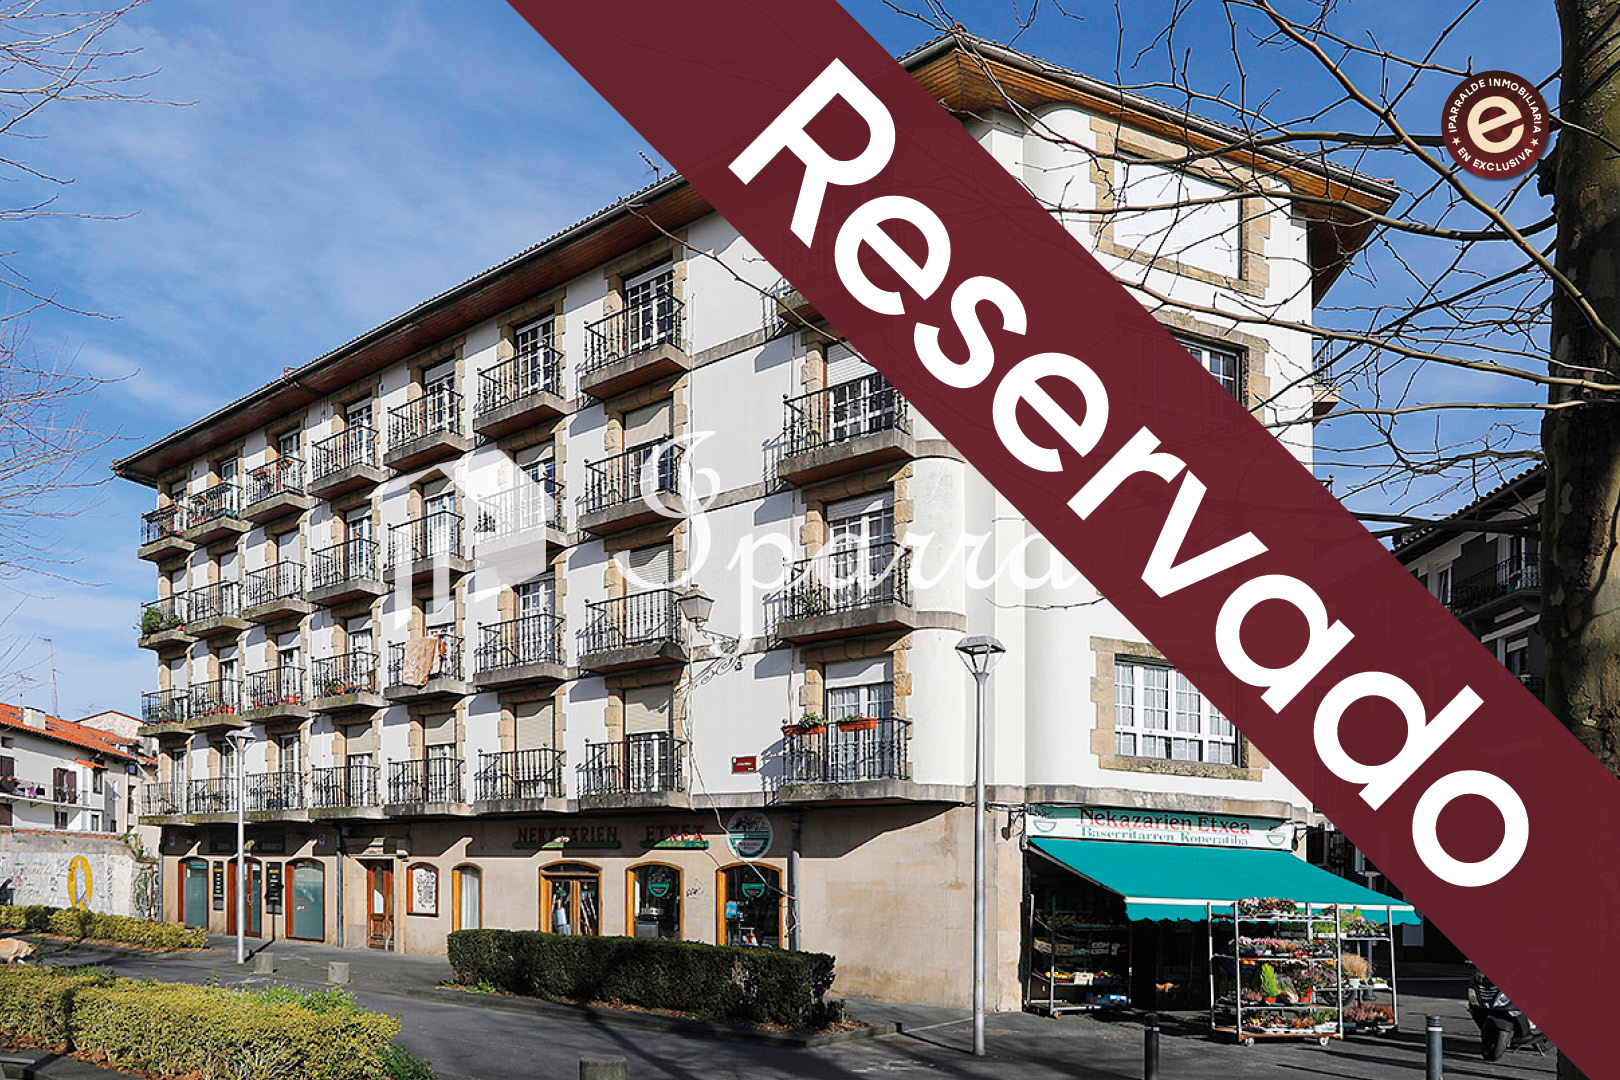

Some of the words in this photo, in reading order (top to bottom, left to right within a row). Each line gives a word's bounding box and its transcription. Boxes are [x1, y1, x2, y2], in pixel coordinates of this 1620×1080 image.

[1080, 808, 1192, 831] Nekazarien
[1198, 816, 1250, 835] Etxea
[518, 826, 618, 843] NEKAZARIEN
[646, 825, 706, 842] ETXEA
[1081, 826, 1174, 841] Baserritarren
